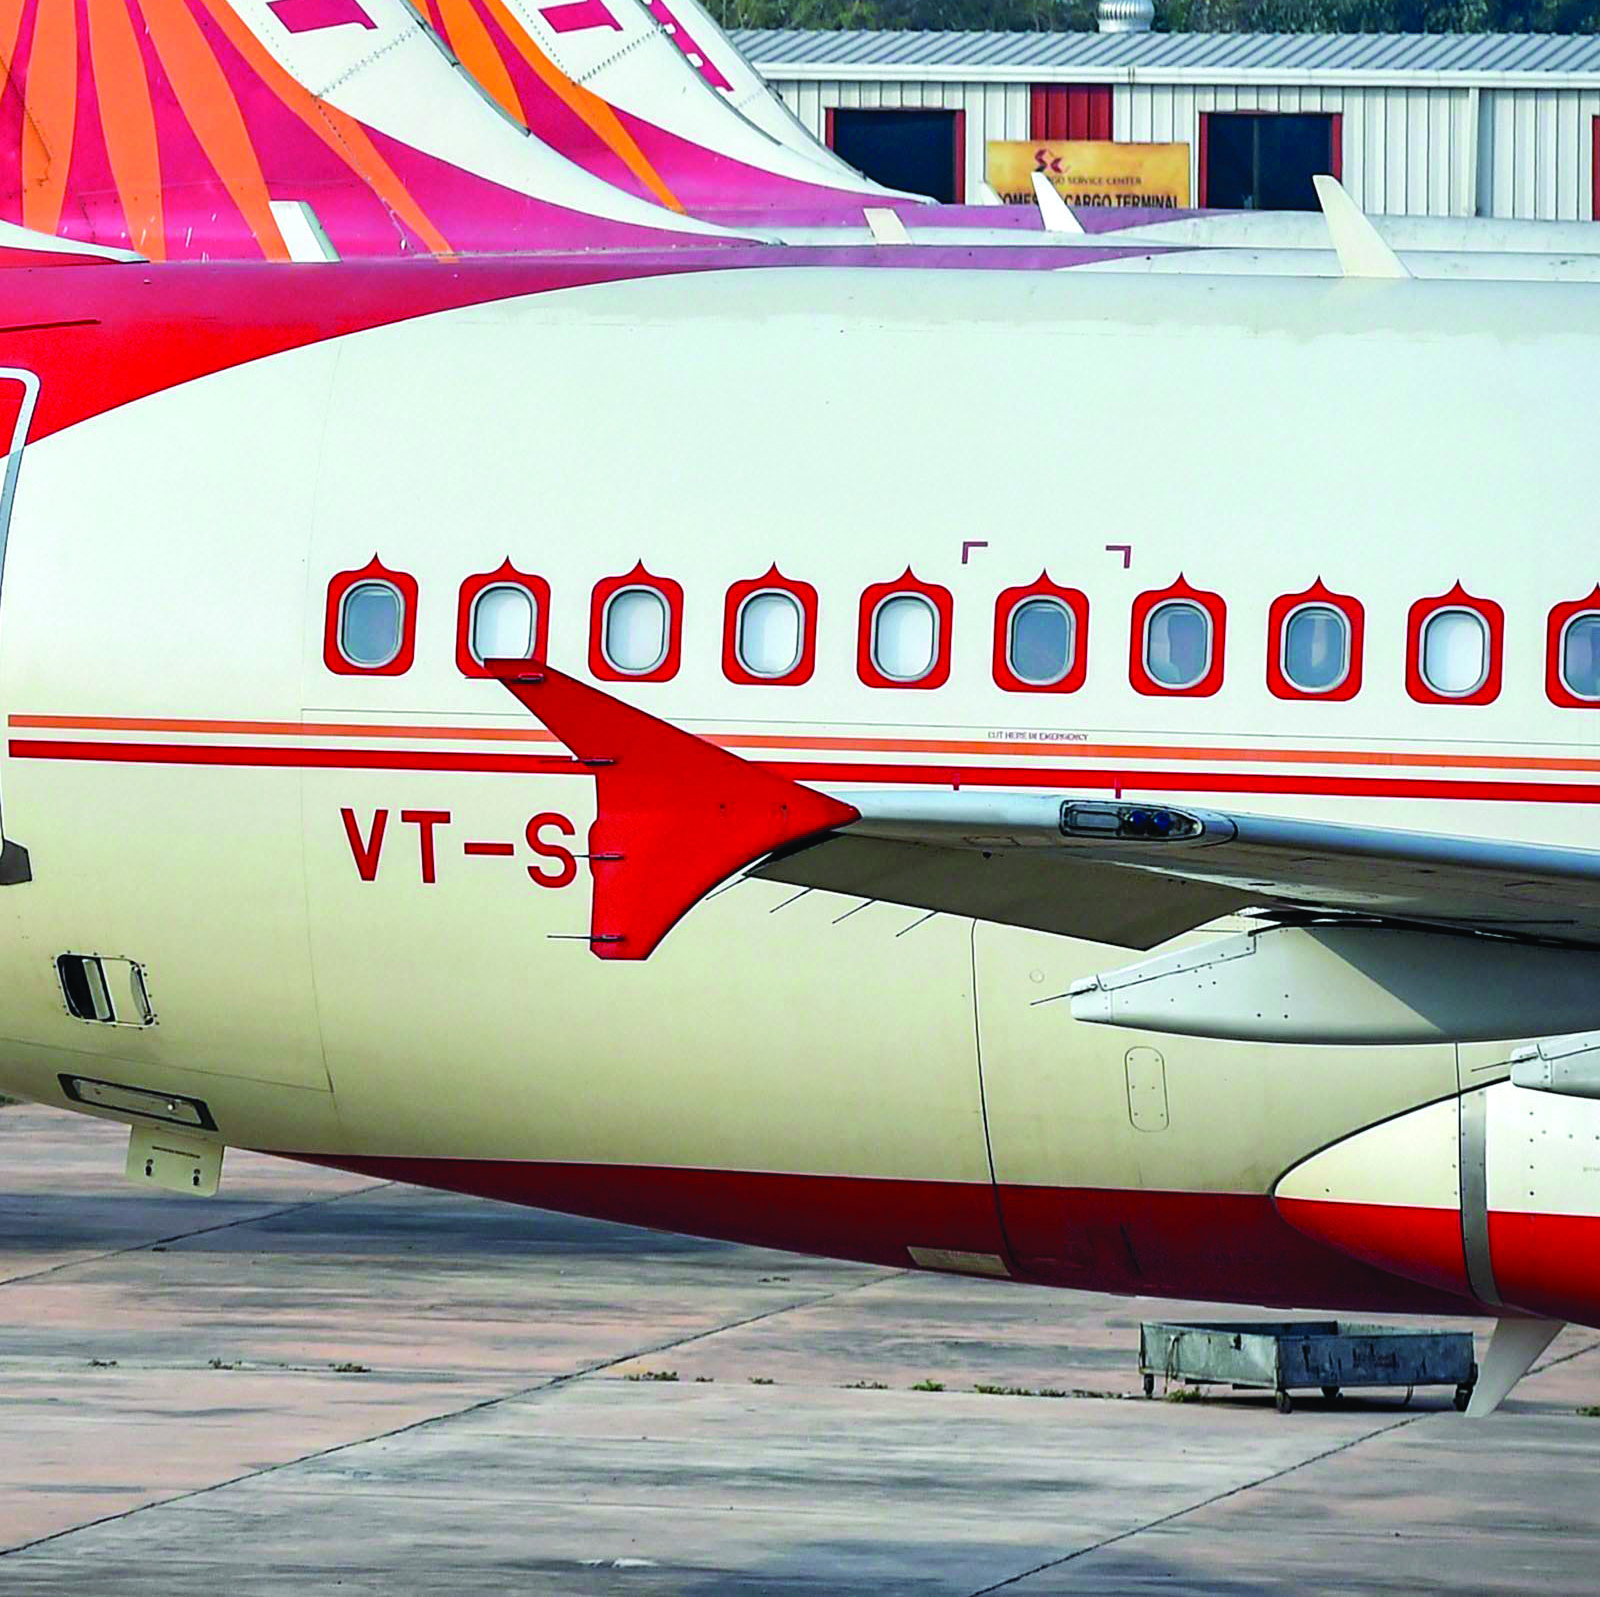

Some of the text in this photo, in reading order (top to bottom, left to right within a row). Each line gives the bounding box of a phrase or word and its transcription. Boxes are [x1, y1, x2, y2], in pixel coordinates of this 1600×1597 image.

[1068, 177, 1104, 185] SERVICE
[1106, 177, 1142, 185] CENTER
[1064, 193, 1112, 208] CARGO
[340, 808, 597, 889] VT-S
